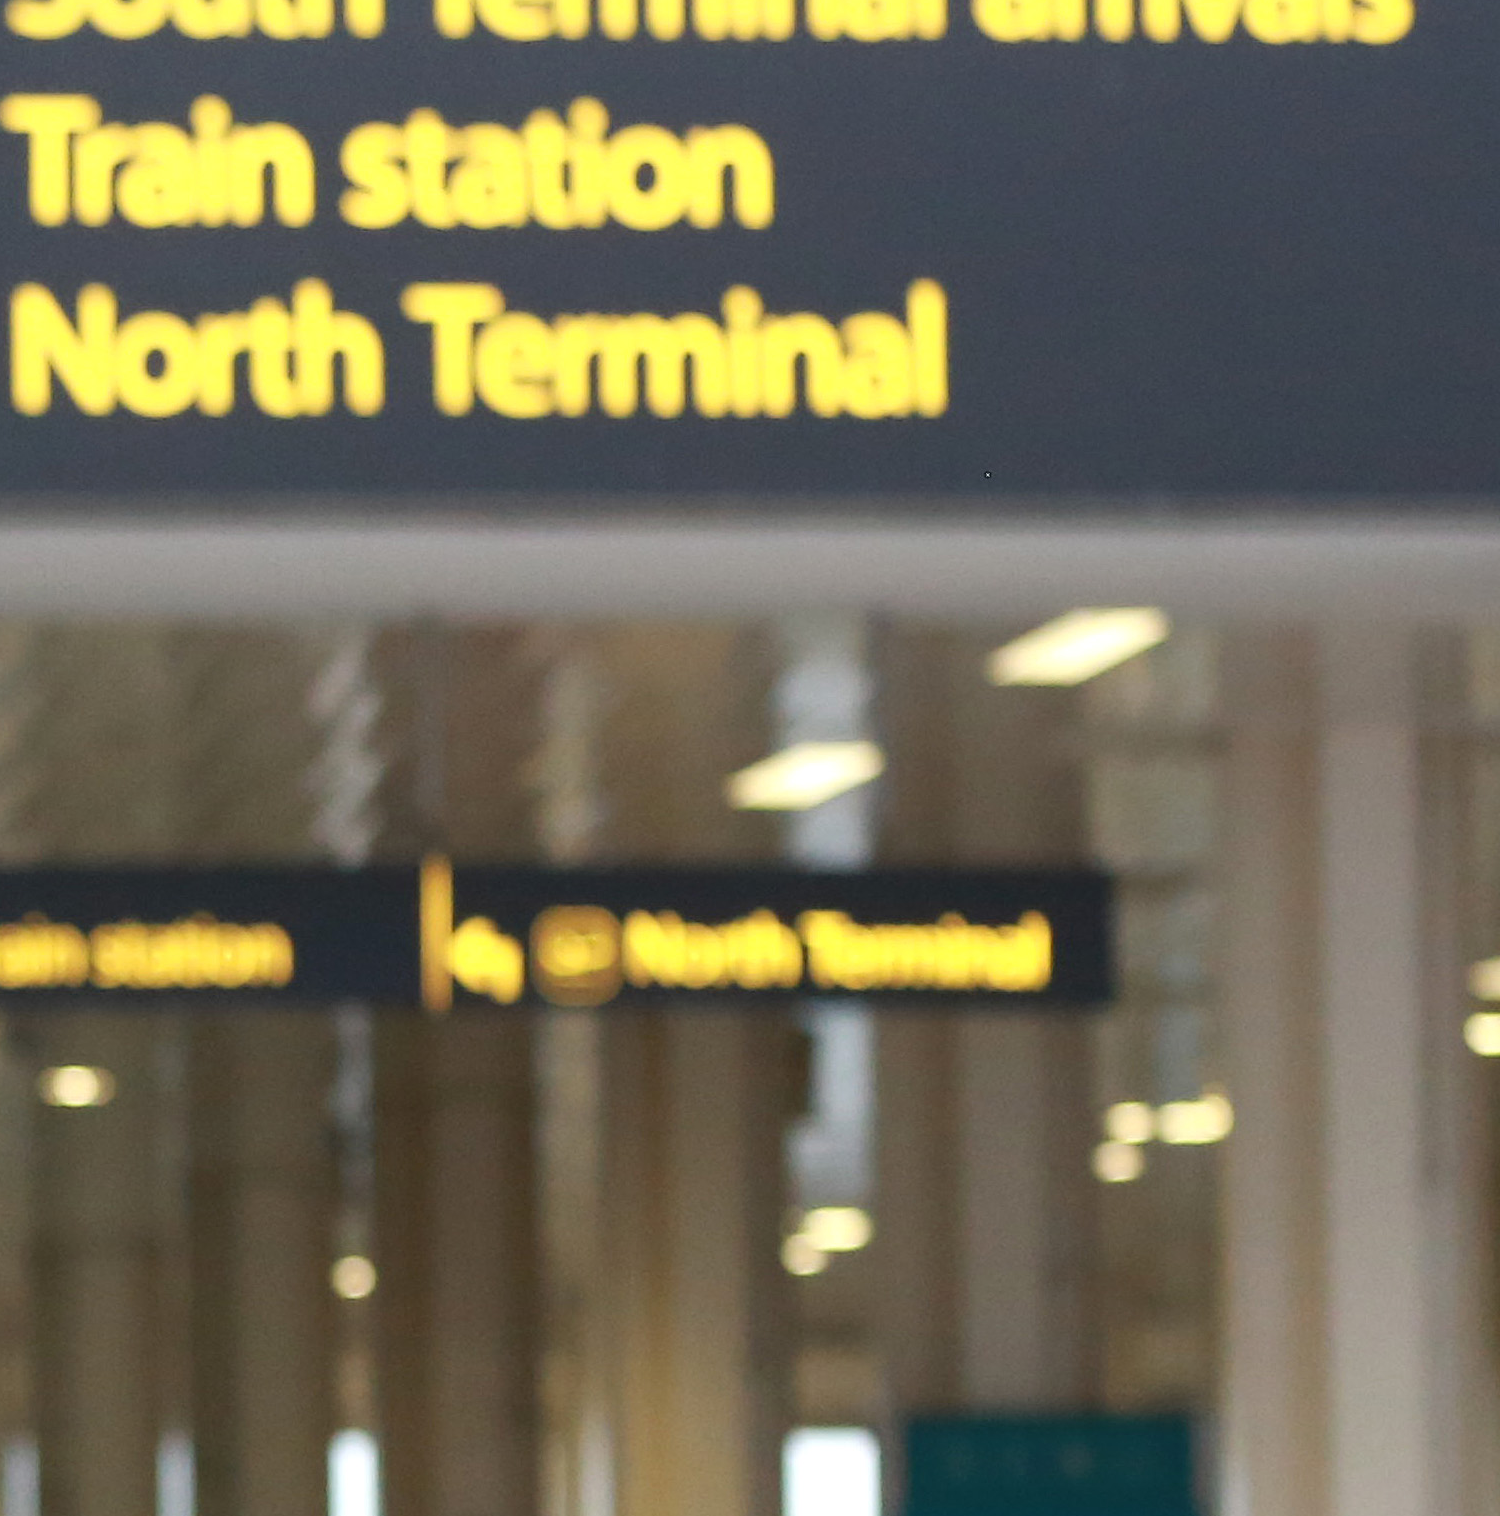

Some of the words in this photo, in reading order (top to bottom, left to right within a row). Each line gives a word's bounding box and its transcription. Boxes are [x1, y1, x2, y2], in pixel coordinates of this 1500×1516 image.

[0, 93, 317, 228] Train
[339, 96, 775, 230] station
[10, 278, 385, 417] North
[401, 279, 949, 419] Terminal
[622, 908, 802, 989] North
